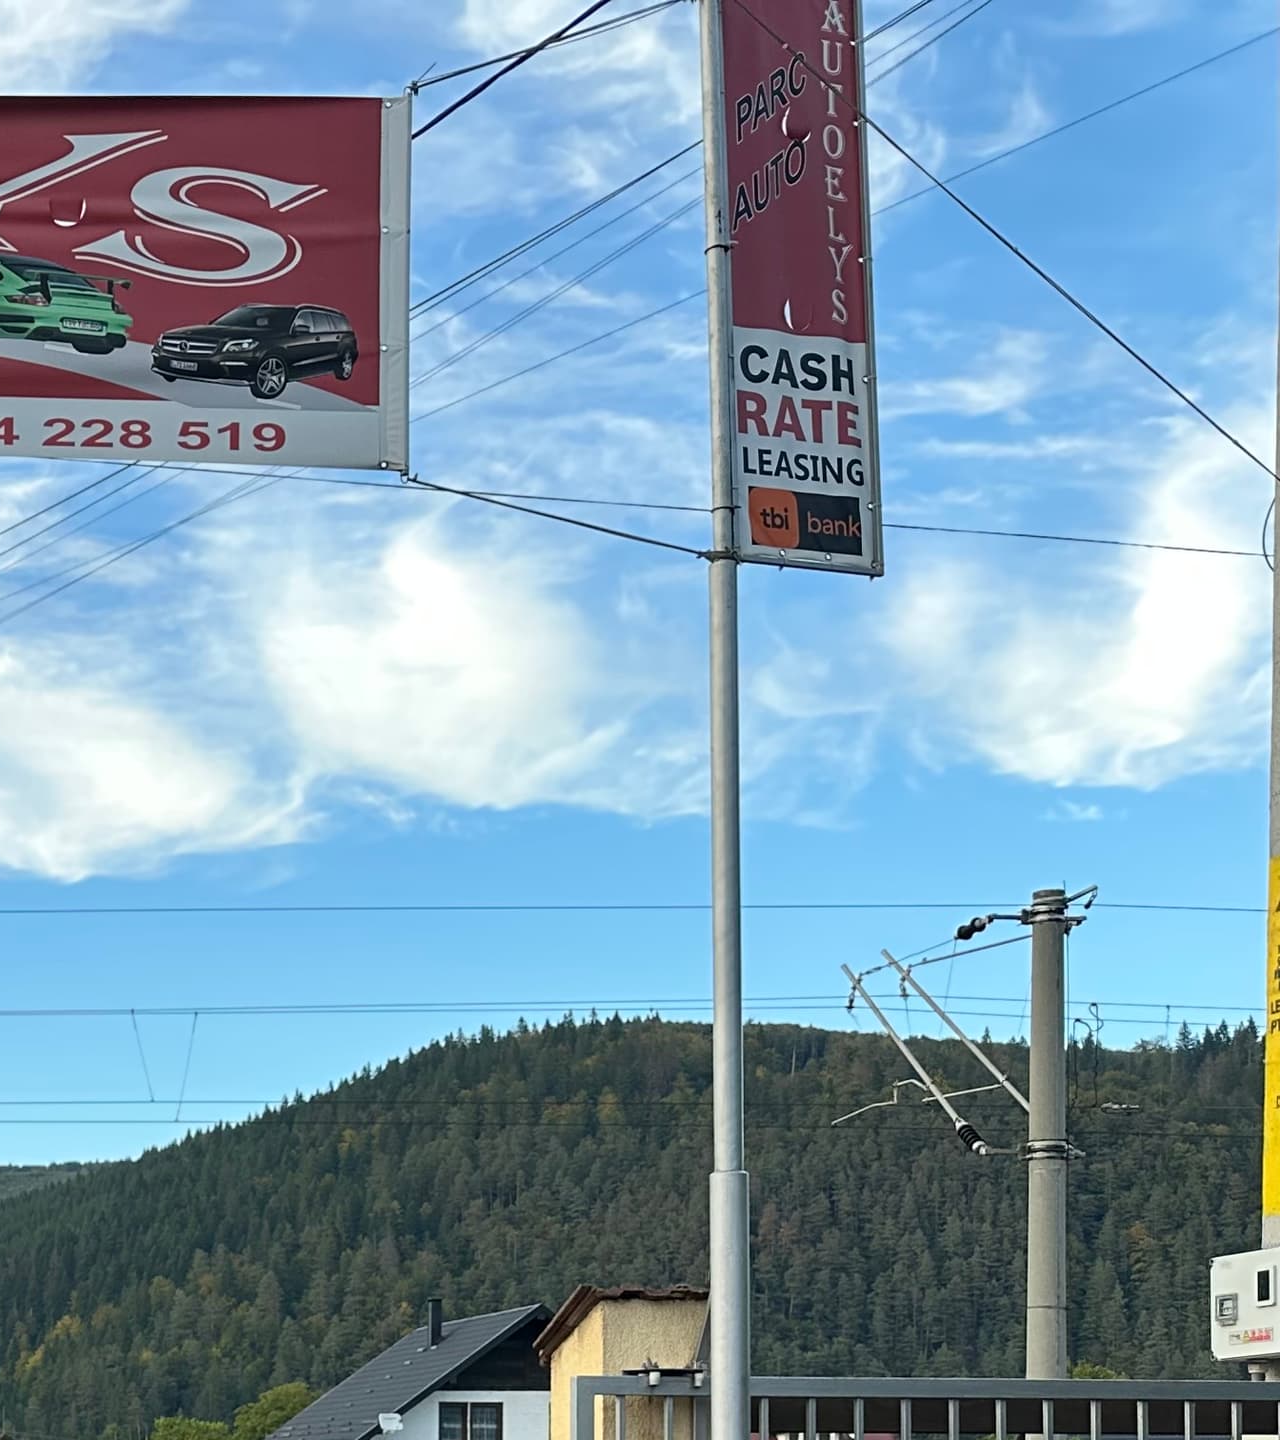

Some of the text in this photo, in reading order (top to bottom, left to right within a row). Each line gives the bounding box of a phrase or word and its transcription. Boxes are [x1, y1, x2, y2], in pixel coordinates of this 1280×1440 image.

[736, 52, 806, 144] PARC
[732, 138, 806, 233] AUTO
[820, 0, 854, 325] AUTOELYS
[739, 345, 855, 396] CASH
[41, 417, 153, 450] 228
[176, 421, 287, 453] 519
[736, 389, 862, 449] RATE
[742, 446, 865, 487] LEASING
[759, 507, 861, 537] tbi bank
